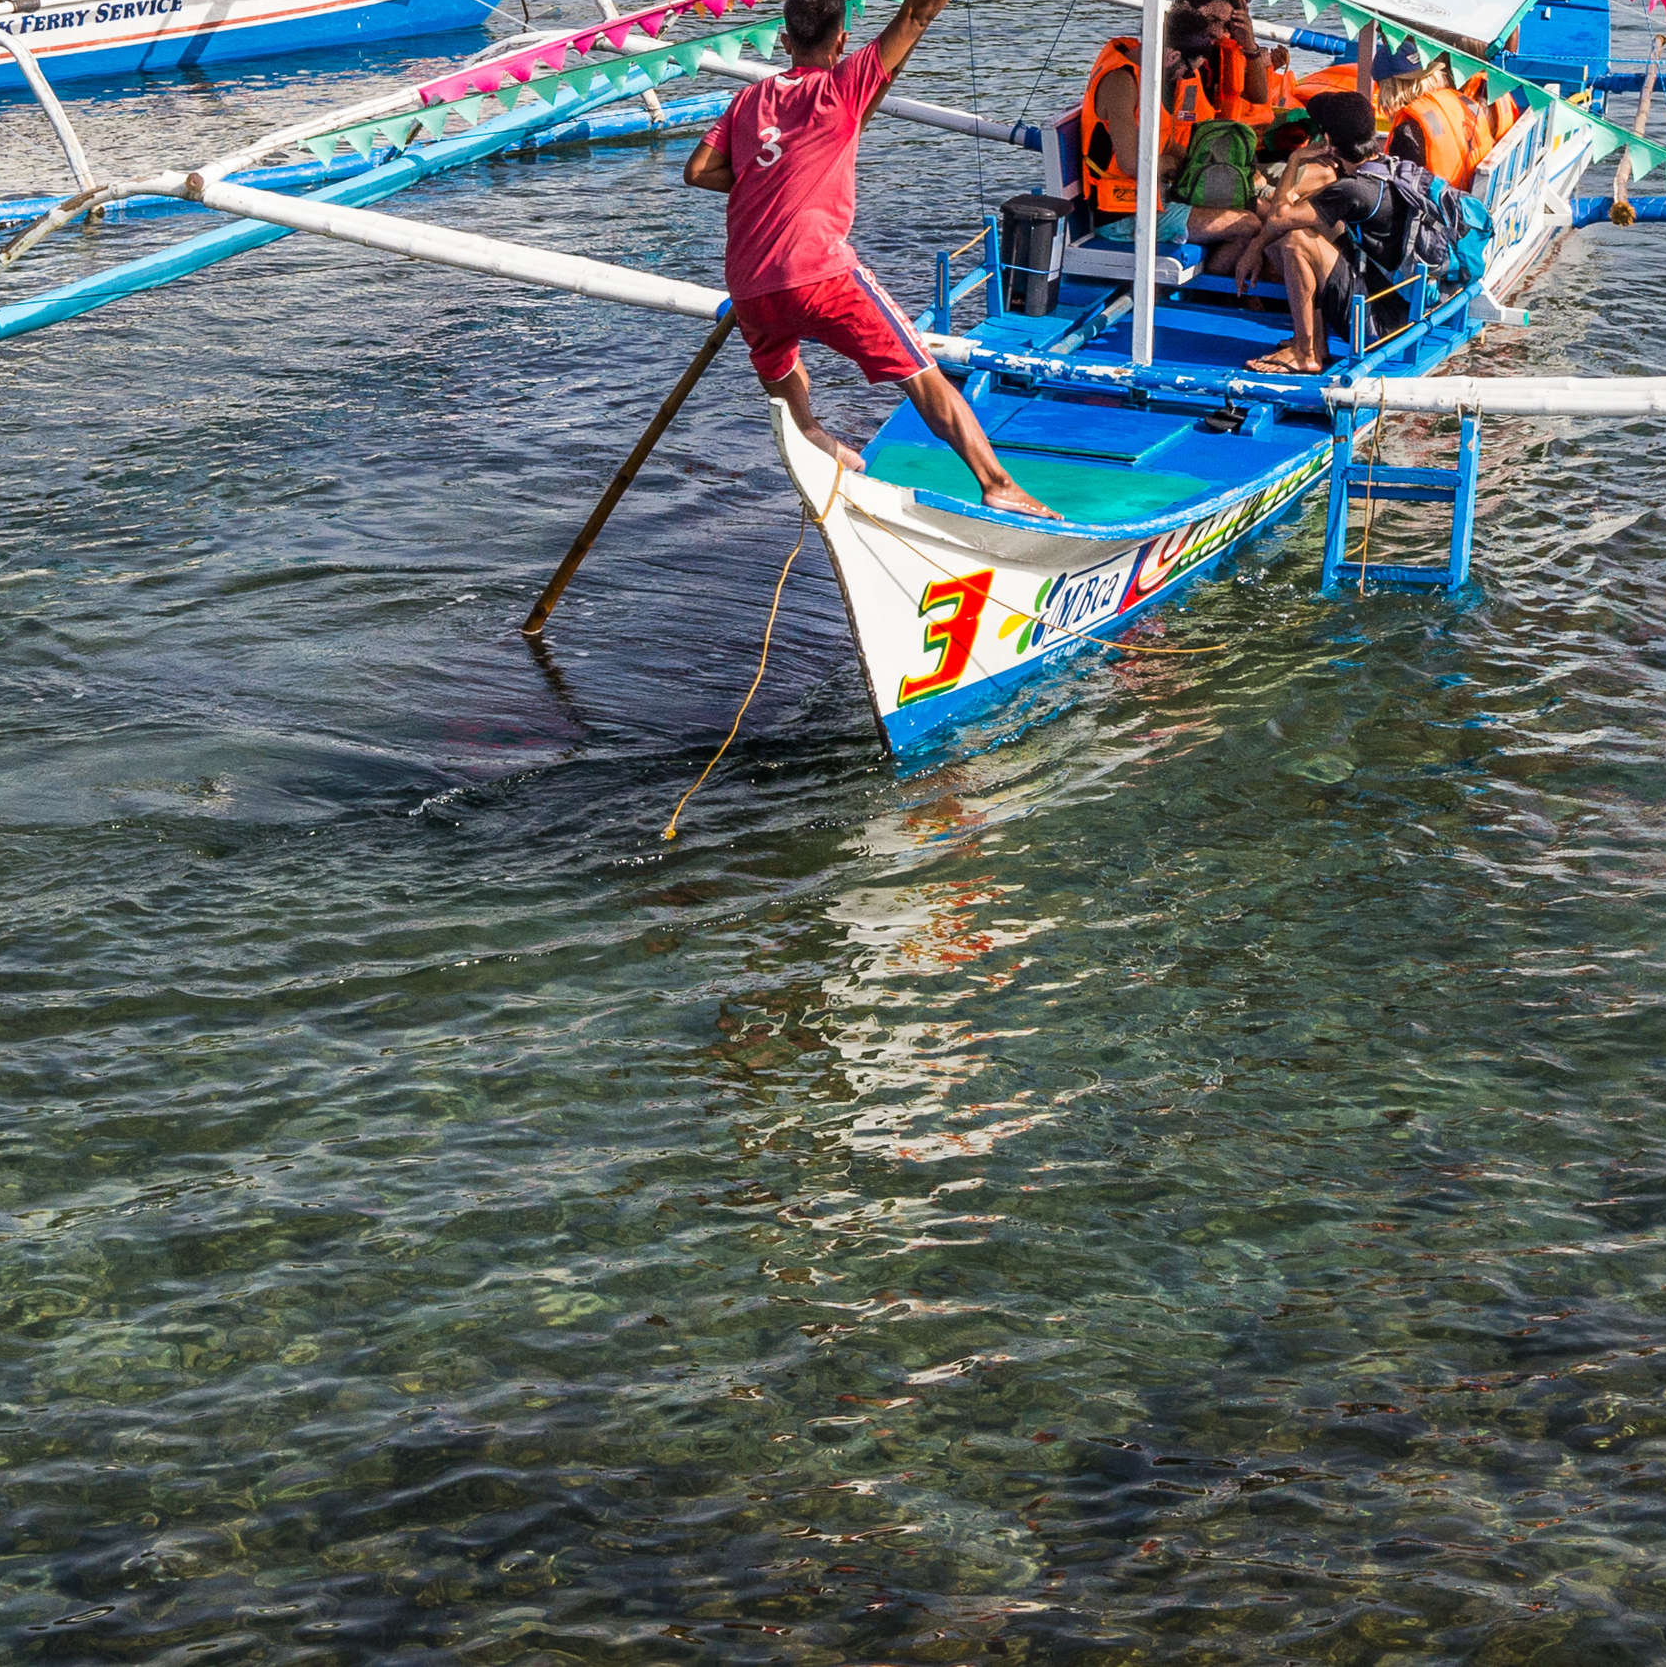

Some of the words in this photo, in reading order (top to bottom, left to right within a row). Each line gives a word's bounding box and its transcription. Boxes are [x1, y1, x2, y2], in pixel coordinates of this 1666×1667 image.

[13, 9, 90, 34] FERRY
[755, 125, 783, 168] 3
[897, 567, 996, 708] 3
